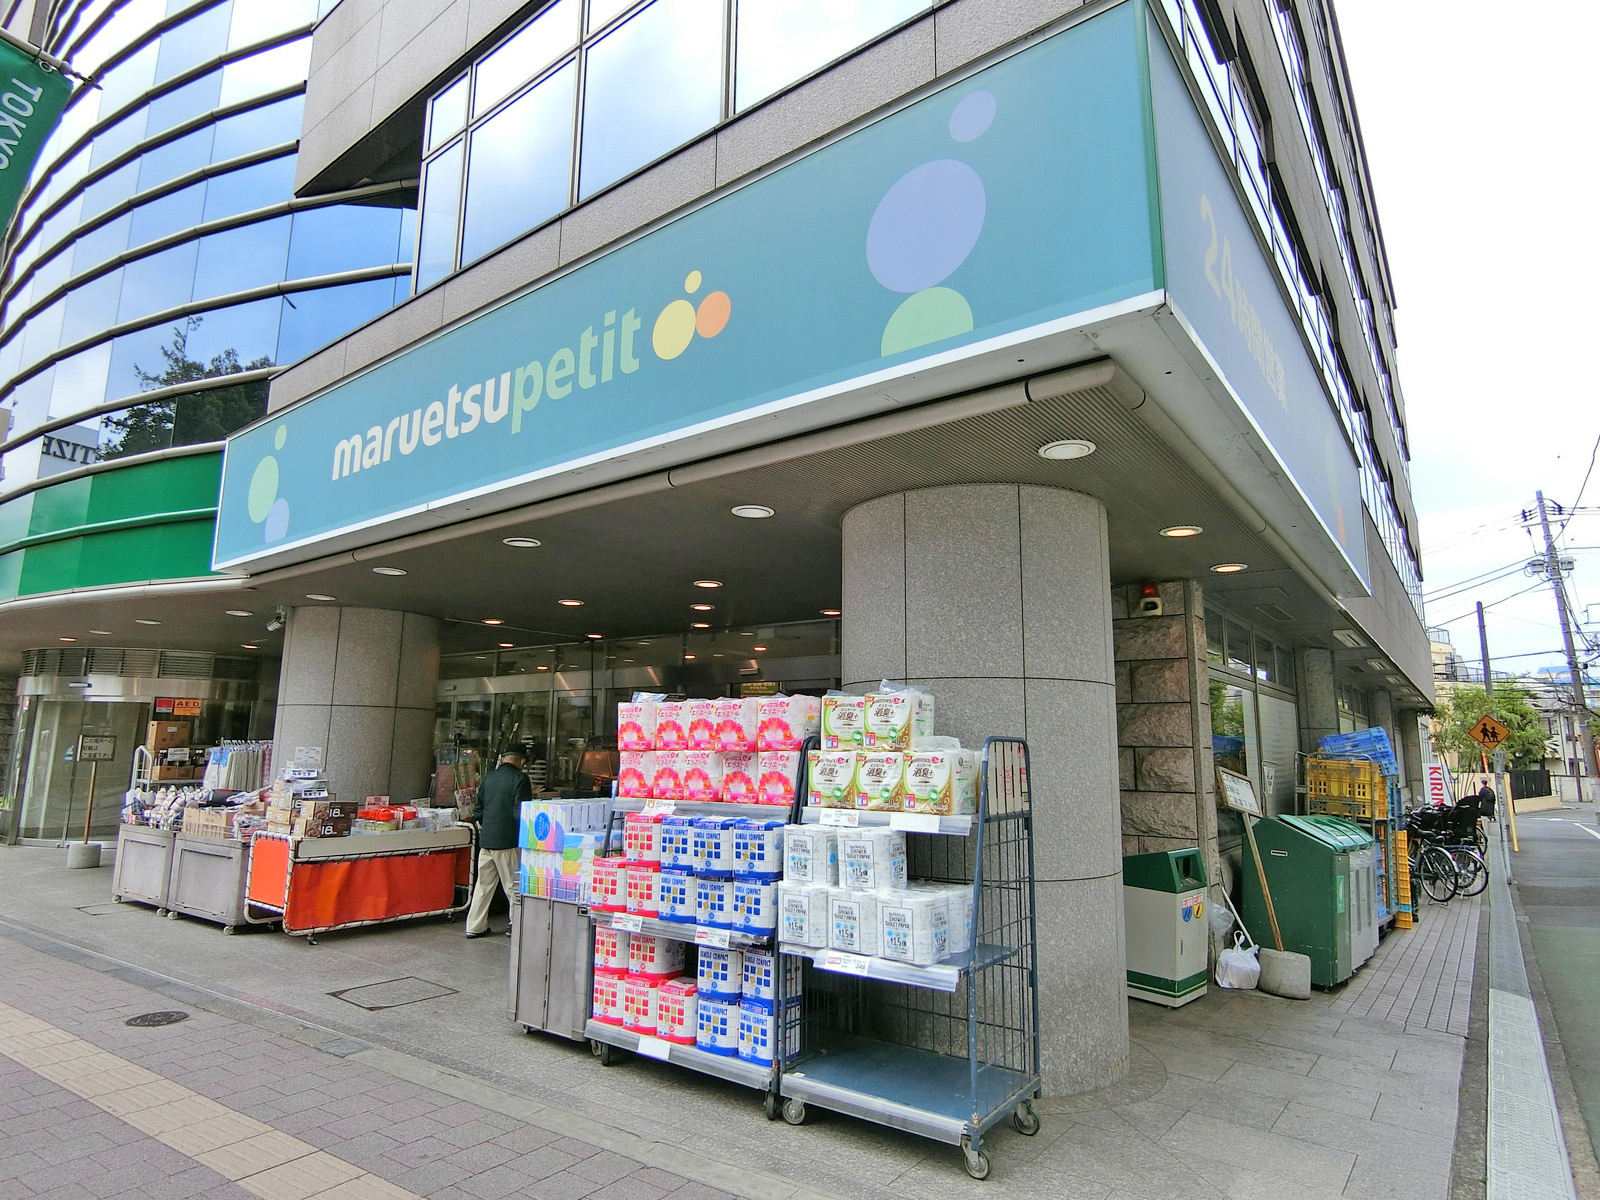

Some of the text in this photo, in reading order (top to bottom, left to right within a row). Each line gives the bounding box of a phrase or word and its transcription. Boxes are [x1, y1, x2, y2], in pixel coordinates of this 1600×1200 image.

[0, 77, 43, 170] TOKY
[1199, 193, 1287, 413] 24時間営業
[1428, 766, 1444, 807] KIRIN
[329, 808, 340, 817] 18
[320, 825, 333, 835] 18
[673, 828, 688, 836] COMPACT
[705, 832, 721, 840] COMPACT
[748, 833, 765, 841] COMPACT
[637, 874, 653, 882] COMPACT
[671, 877, 686, 886] COMPACT
[708, 883, 725, 892] COMPACT
[745, 887, 761, 895] COMPACT
[641, 936, 656, 944] COMPACT
[712, 952, 729, 962] COMPACT
[755, 956, 771, 967] COMPACT
[604, 981, 617, 989] COMPACT
[635, 988, 649, 998] COMPACT
[670, 997, 684, 1006] COMPACT
[711, 1005, 728, 1015] COMPACT
[751, 1014, 768, 1026] COMPACT
